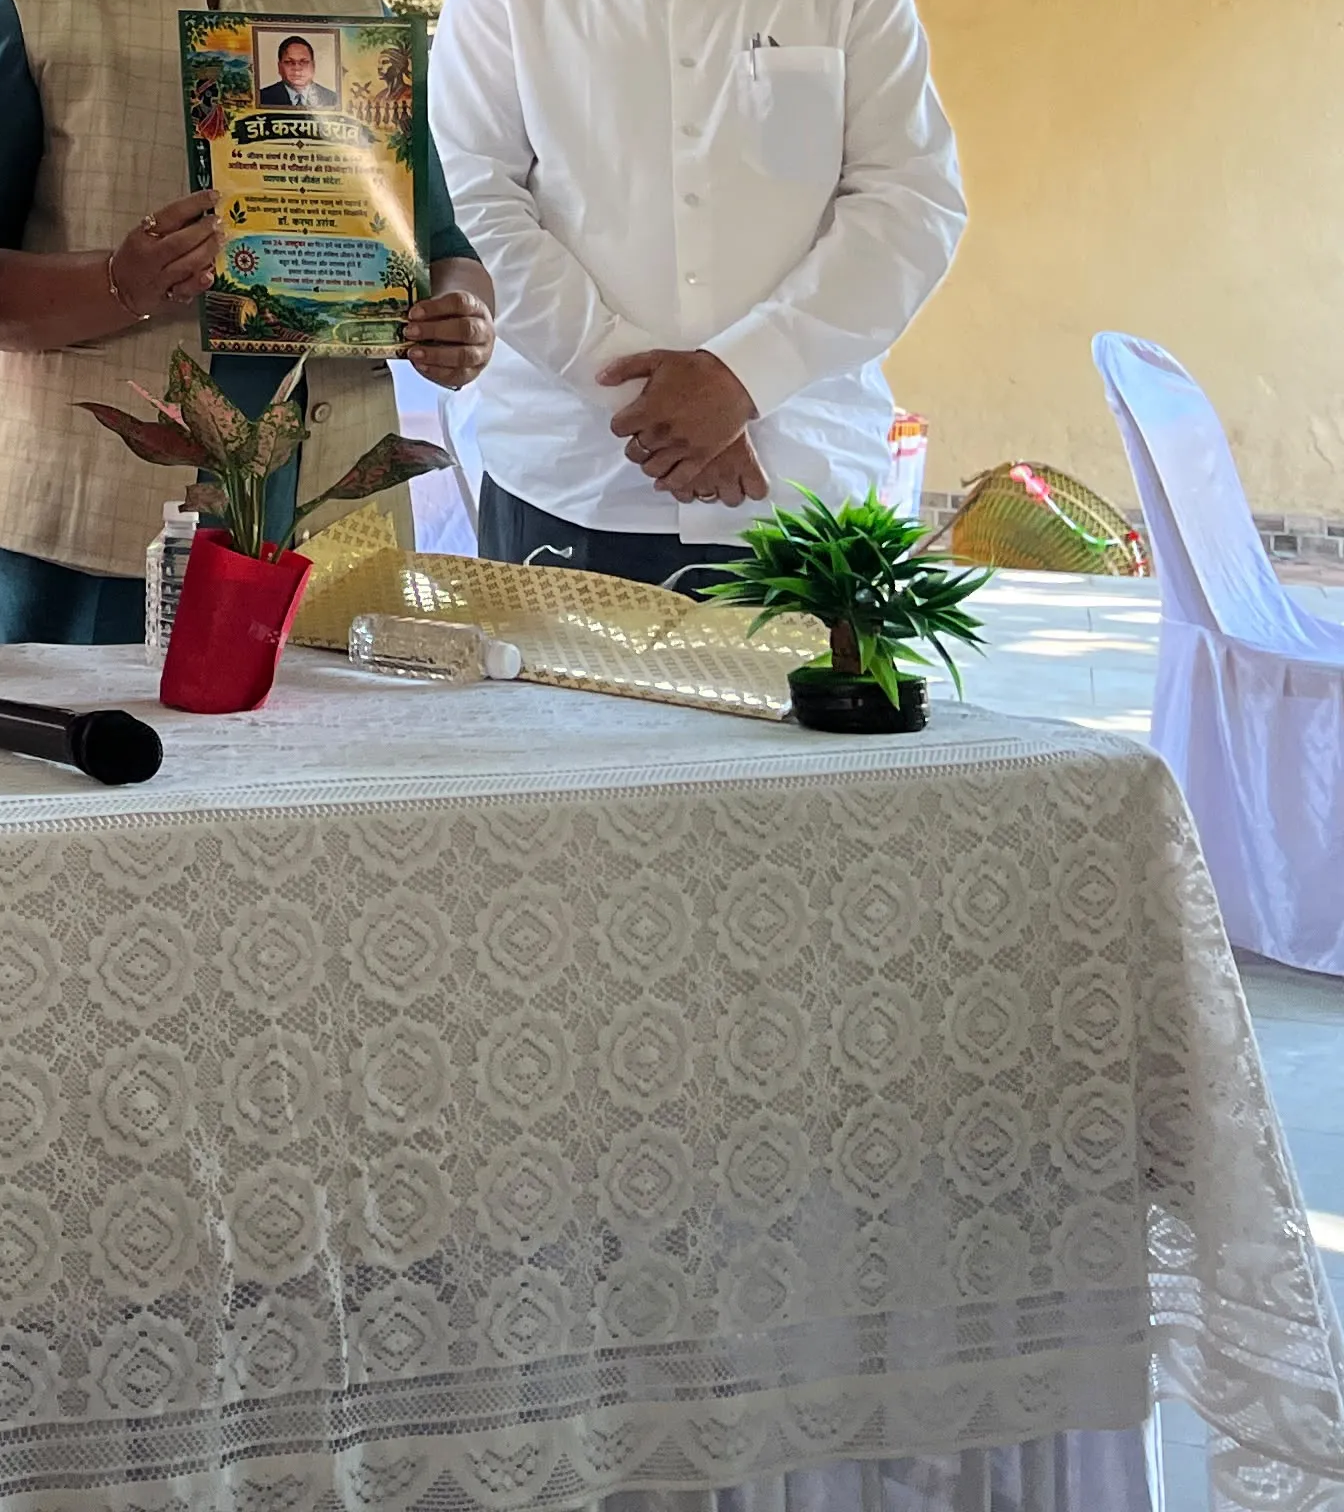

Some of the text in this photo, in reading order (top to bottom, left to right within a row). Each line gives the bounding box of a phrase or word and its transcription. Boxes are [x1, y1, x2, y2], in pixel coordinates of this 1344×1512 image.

[245, 116, 360, 142] डॉ. करमा उरांव
